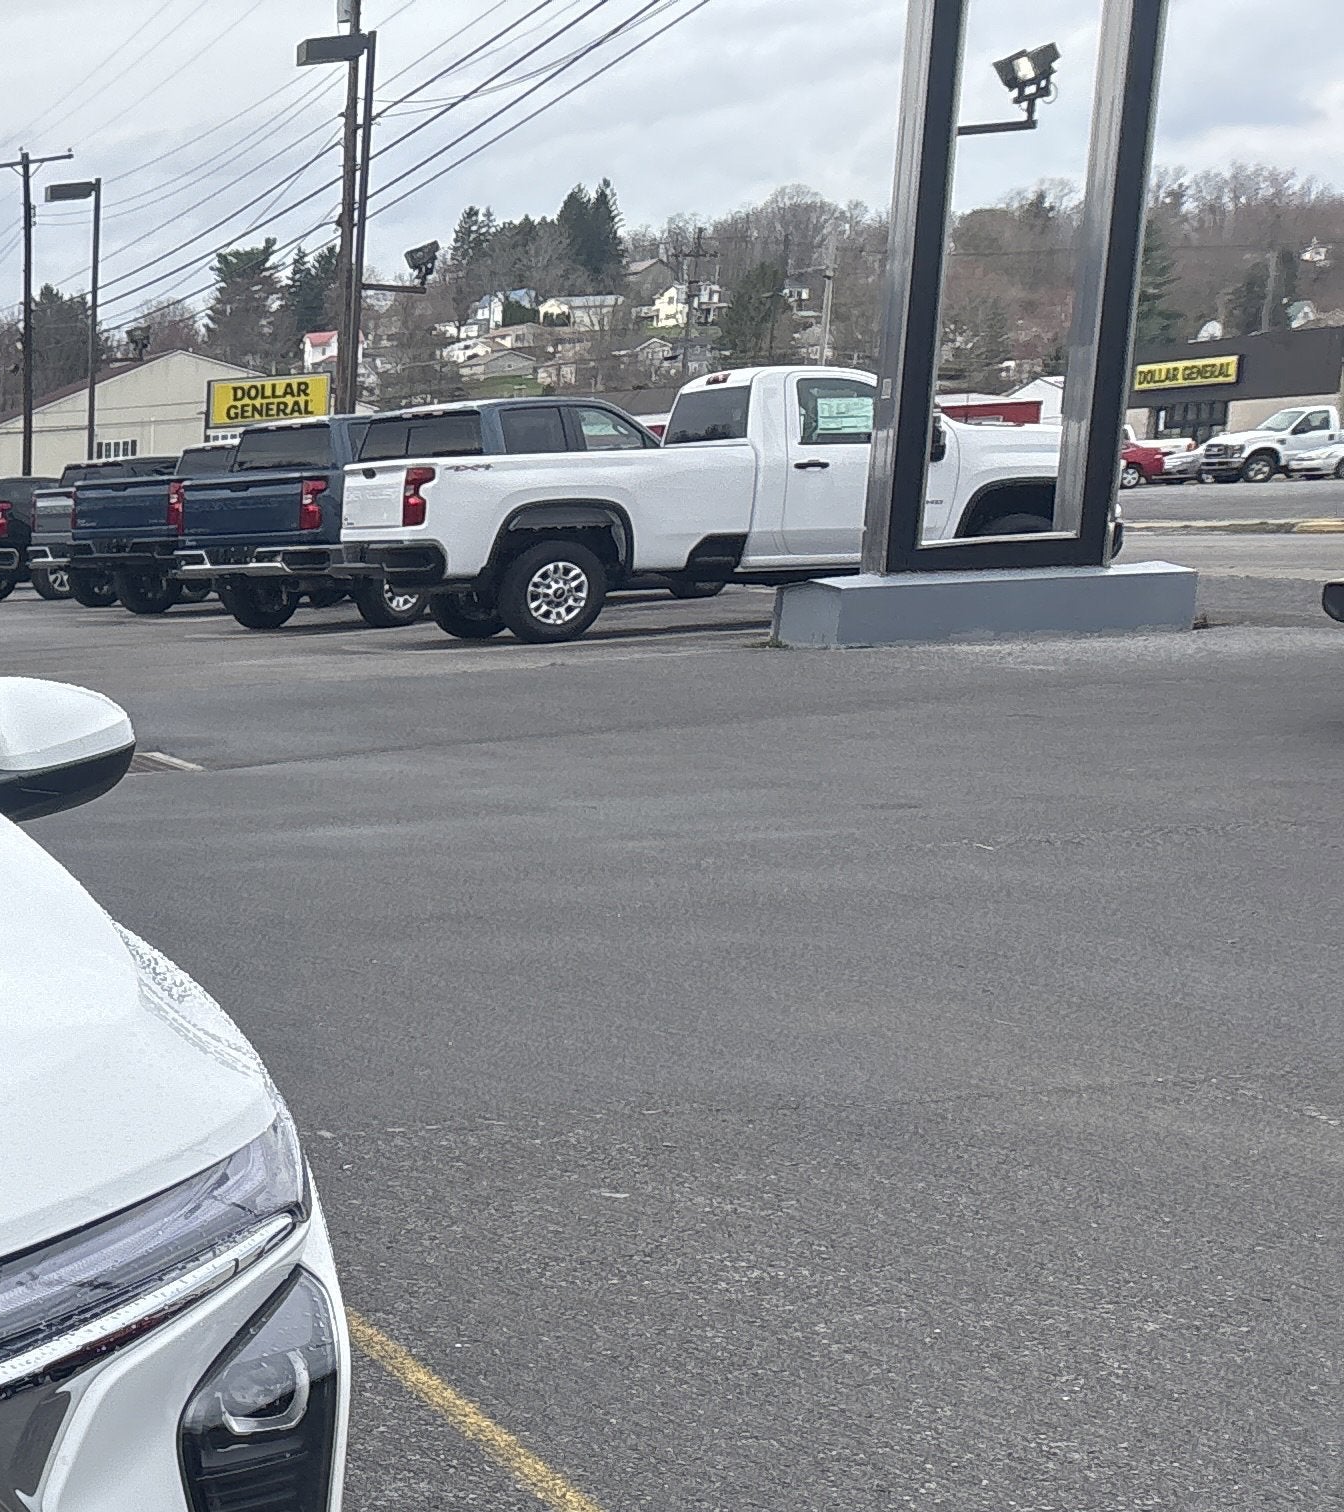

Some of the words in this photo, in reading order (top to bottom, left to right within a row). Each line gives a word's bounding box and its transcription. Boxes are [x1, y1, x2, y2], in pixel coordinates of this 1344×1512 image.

[1137, 367, 1179, 385] DOLLAR
[1182, 361, 1232, 380] GENERAL
[233, 381, 310, 402] DOLLAR
[225, 400, 315, 420] GENERAL
